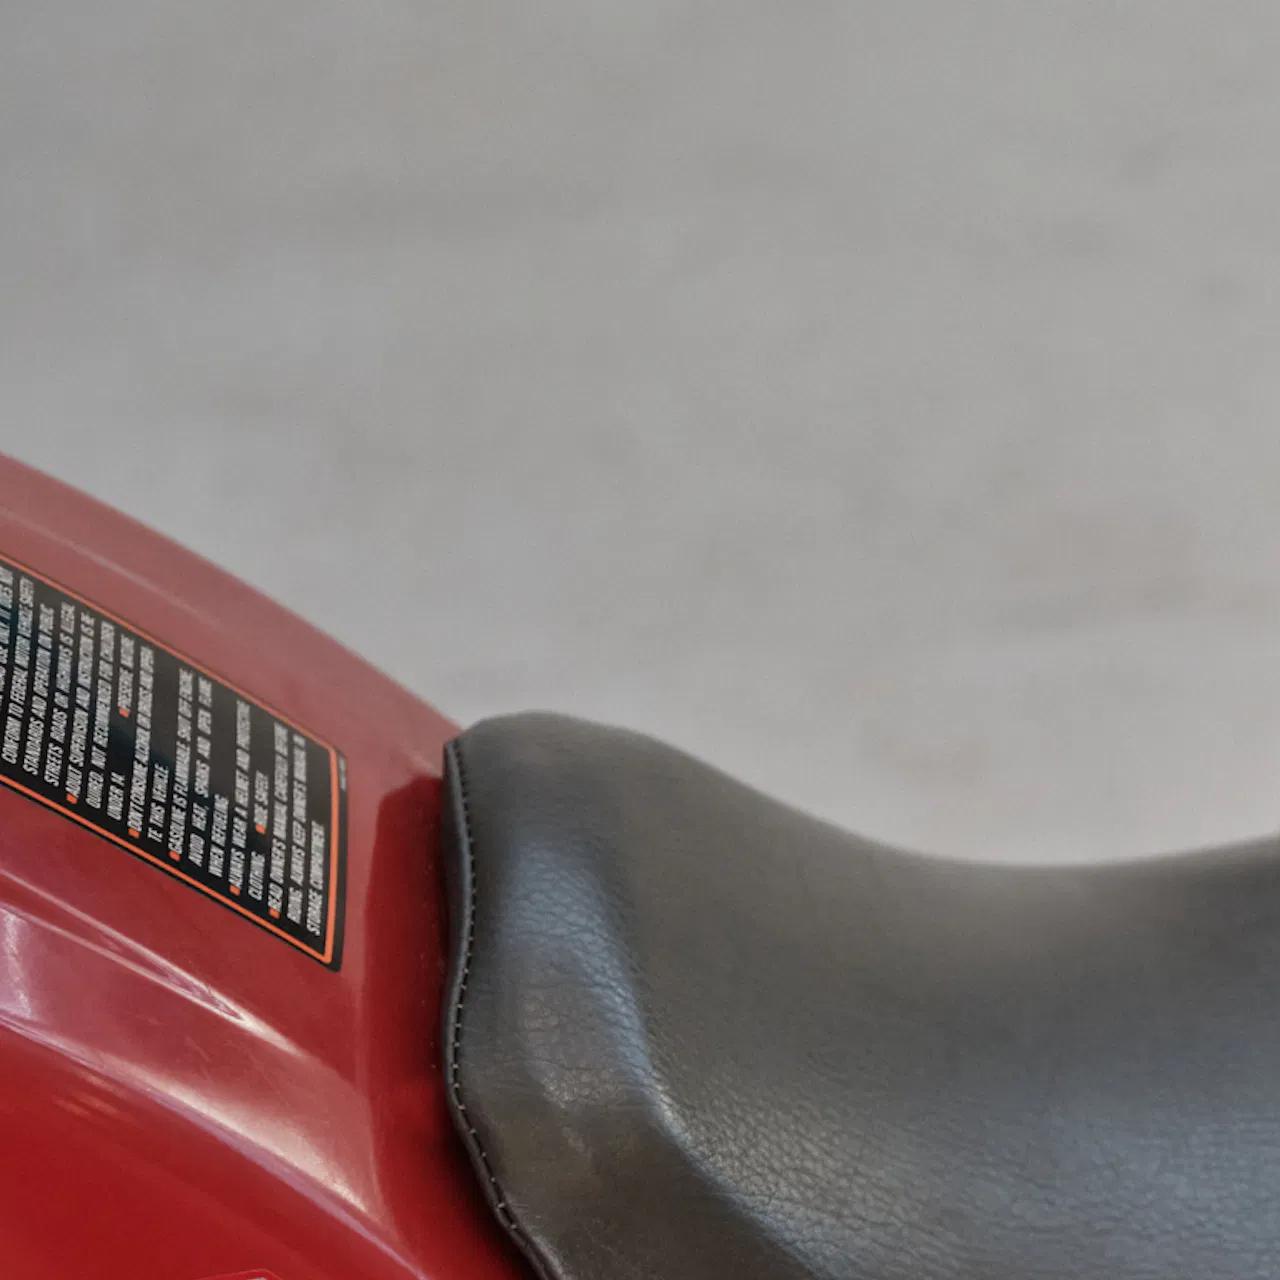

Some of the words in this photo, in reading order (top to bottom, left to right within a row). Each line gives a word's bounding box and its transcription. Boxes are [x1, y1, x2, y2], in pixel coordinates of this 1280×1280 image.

[19, 577, 34, 607] SAFETY
[17, 604, 32, 637] VEHICLE
[39, 603, 53, 635] PUBLIC
[81, 624, 94, 636] IS
[14, 635, 30, 667] MOTOR
[38, 633, 51, 648] ON
[60, 633, 73, 646] IS
[100, 621, 114, 661] CHILDREN
[34, 647, 50, 696] OPERATION
[55, 644, 72, 692] HIGHWAYS
[77, 635, 93, 688] INSTRUCTION
[99, 660, 112, 680] FOR
[10, 665, 27, 704] FEDERAL
[118, 667, 133, 711] PRESERVE
[140, 671, 153, 689] AND
[9, 702, 23, 717] TO
[31, 695, 46, 718] AND
[54, 691, 68, 708] OR
[75, 687, 90, 709] AND
[93, 679, 111, 747] RECOMMENDED
[138, 687, 152, 716] DRUGS
[179, 699, 191, 717] OFF
[50, 707, 66, 742] ROADS
[70, 707, 88, 766] SUPERVISION
[137, 714, 150, 728] OR
[177, 716, 191, 741] SHUT
[198, 708, 211, 734] OPEN
[237, 700, 250, 750] PROTECTIVE
[2, 716, 21, 763] CONFORM
[24, 716, 44, 775] STANDARDS
[135, 727, 150, 763] ALCOHOL
[197, 736, 210, 758] AND
[275, 723, 288, 756] BEFORE
[45, 743, 63, 787] STREETS
[91, 746, 106, 769] NOT
[237, 749, 250, 771] AND
[294, 747, 306, 782] MANUAL
[66, 766, 82, 796] ADULT
[131, 760, 147, 805] CONSUME
[235, 770, 249, 807] HELMET
[274, 754, 288, 802] CAREFULLY
[108, 785, 124, 820] UNDER
[129, 802, 144, 831] DON'T
[150, 802, 165, 827] THIS
[173, 794, 186, 808] IS
[192, 800, 207, 831] HEAT,
[235, 806, 247, 818] A
[254, 803, 267, 827] RIDE
[149, 828, 163, 842] TE
[169, 806, 185, 854] GASOLINE
[233, 817, 247, 848] WEAR
[273, 800, 287, 840] MANUAL
[293, 820, 305, 847] KEEP
[189, 833, 205, 866] AVOID
[209, 845, 224, 877] WHEN
[270, 838, 285, 884] OWNER'S
[230, 848, 245, 888] ALWAYS
[291, 846, 305, 886] ALWAYS
[268, 883, 282, 911] READ
[307, 889, 321, 935] STORAGE
